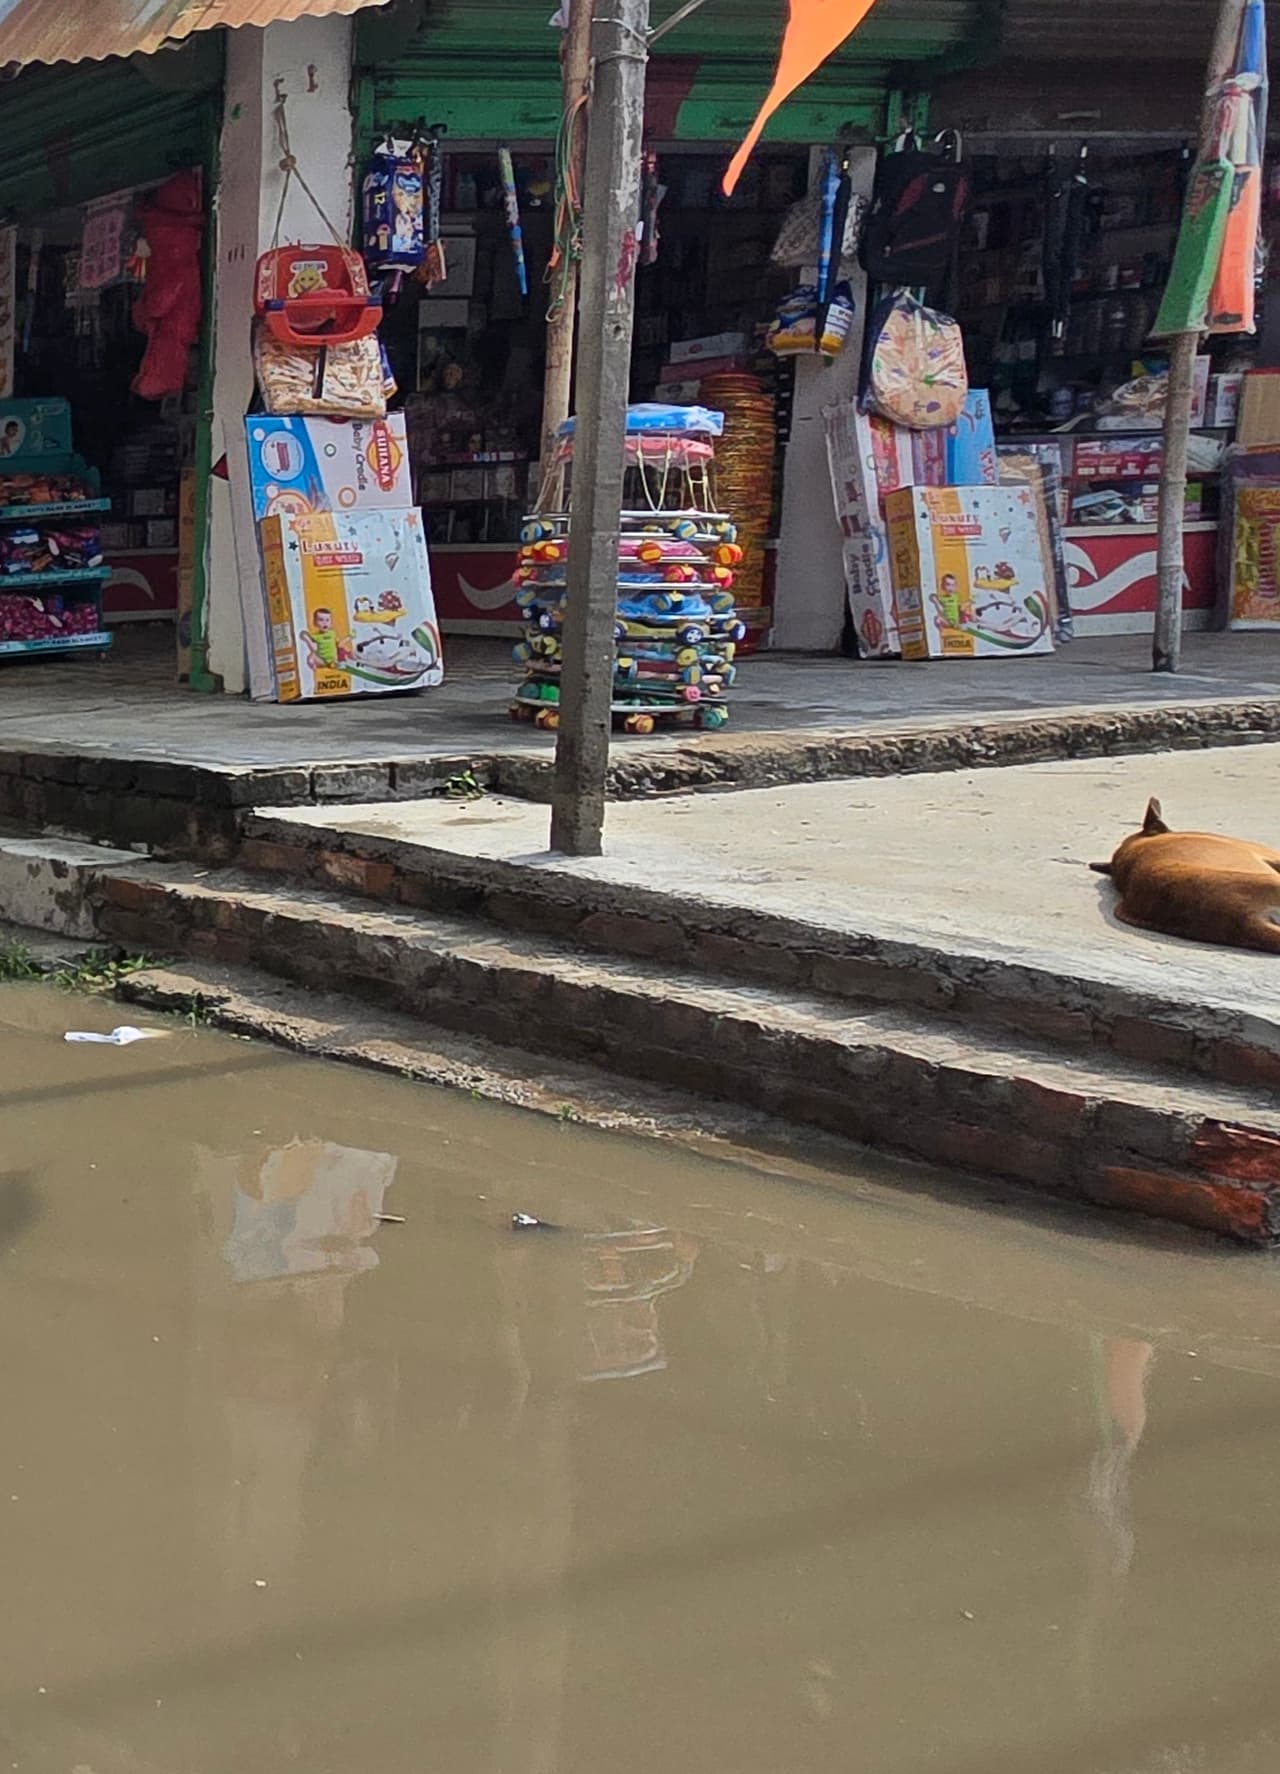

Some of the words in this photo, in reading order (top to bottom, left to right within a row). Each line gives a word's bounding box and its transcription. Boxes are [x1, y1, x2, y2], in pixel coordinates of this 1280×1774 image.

[376, 429, 391, 483] SUHANA
[931, 512, 979, 525] Luxury
[302, 541, 359, 553] Luxury
[317, 679, 348, 690] INDIA
